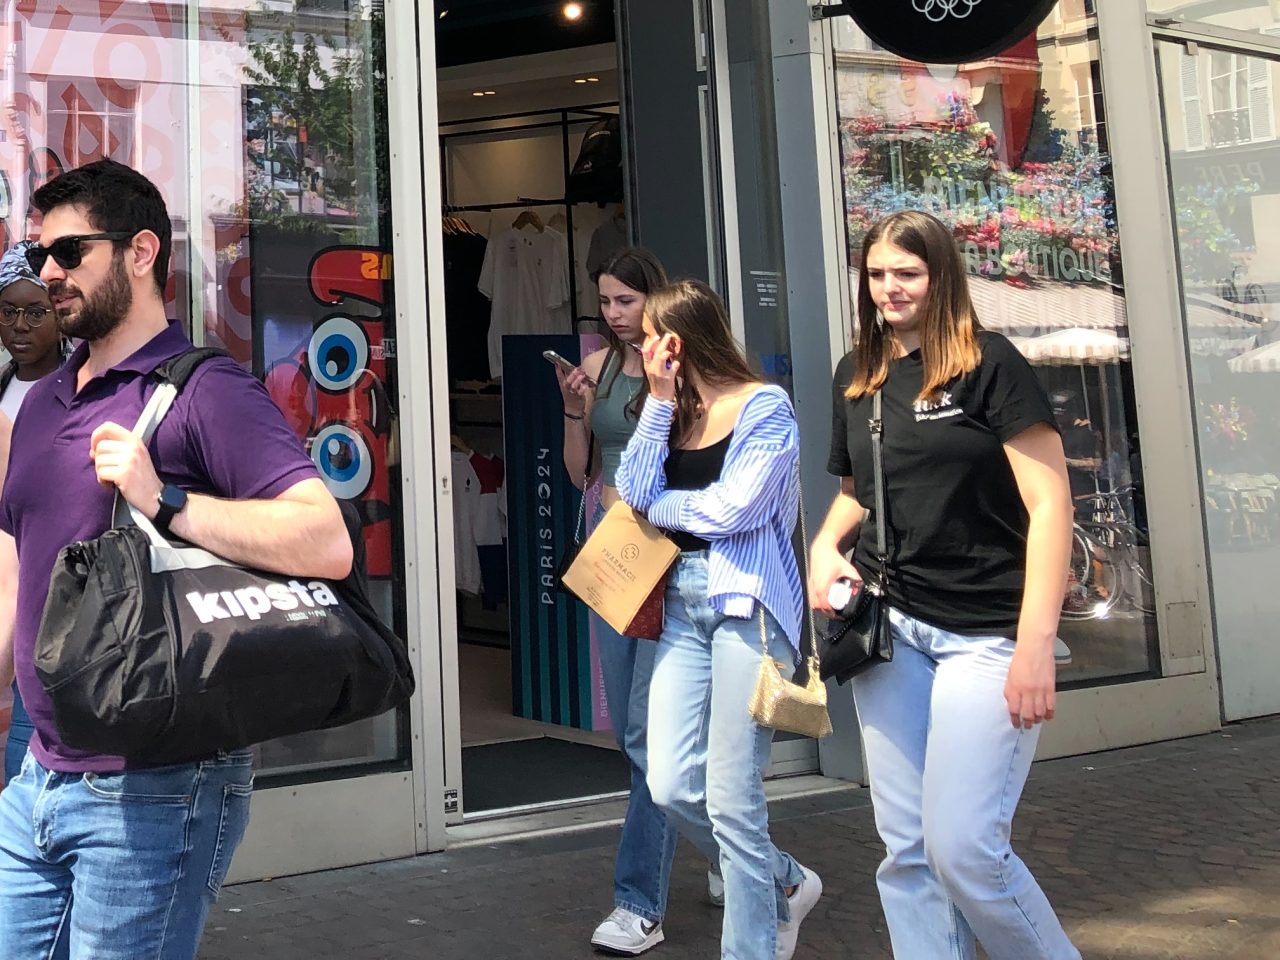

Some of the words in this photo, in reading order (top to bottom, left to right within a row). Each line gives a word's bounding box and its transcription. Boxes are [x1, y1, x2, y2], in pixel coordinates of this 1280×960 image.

[537, 447, 552, 517] 2024
[185, 579, 339, 624] kipsta
[540, 529, 554, 605] PARIS
